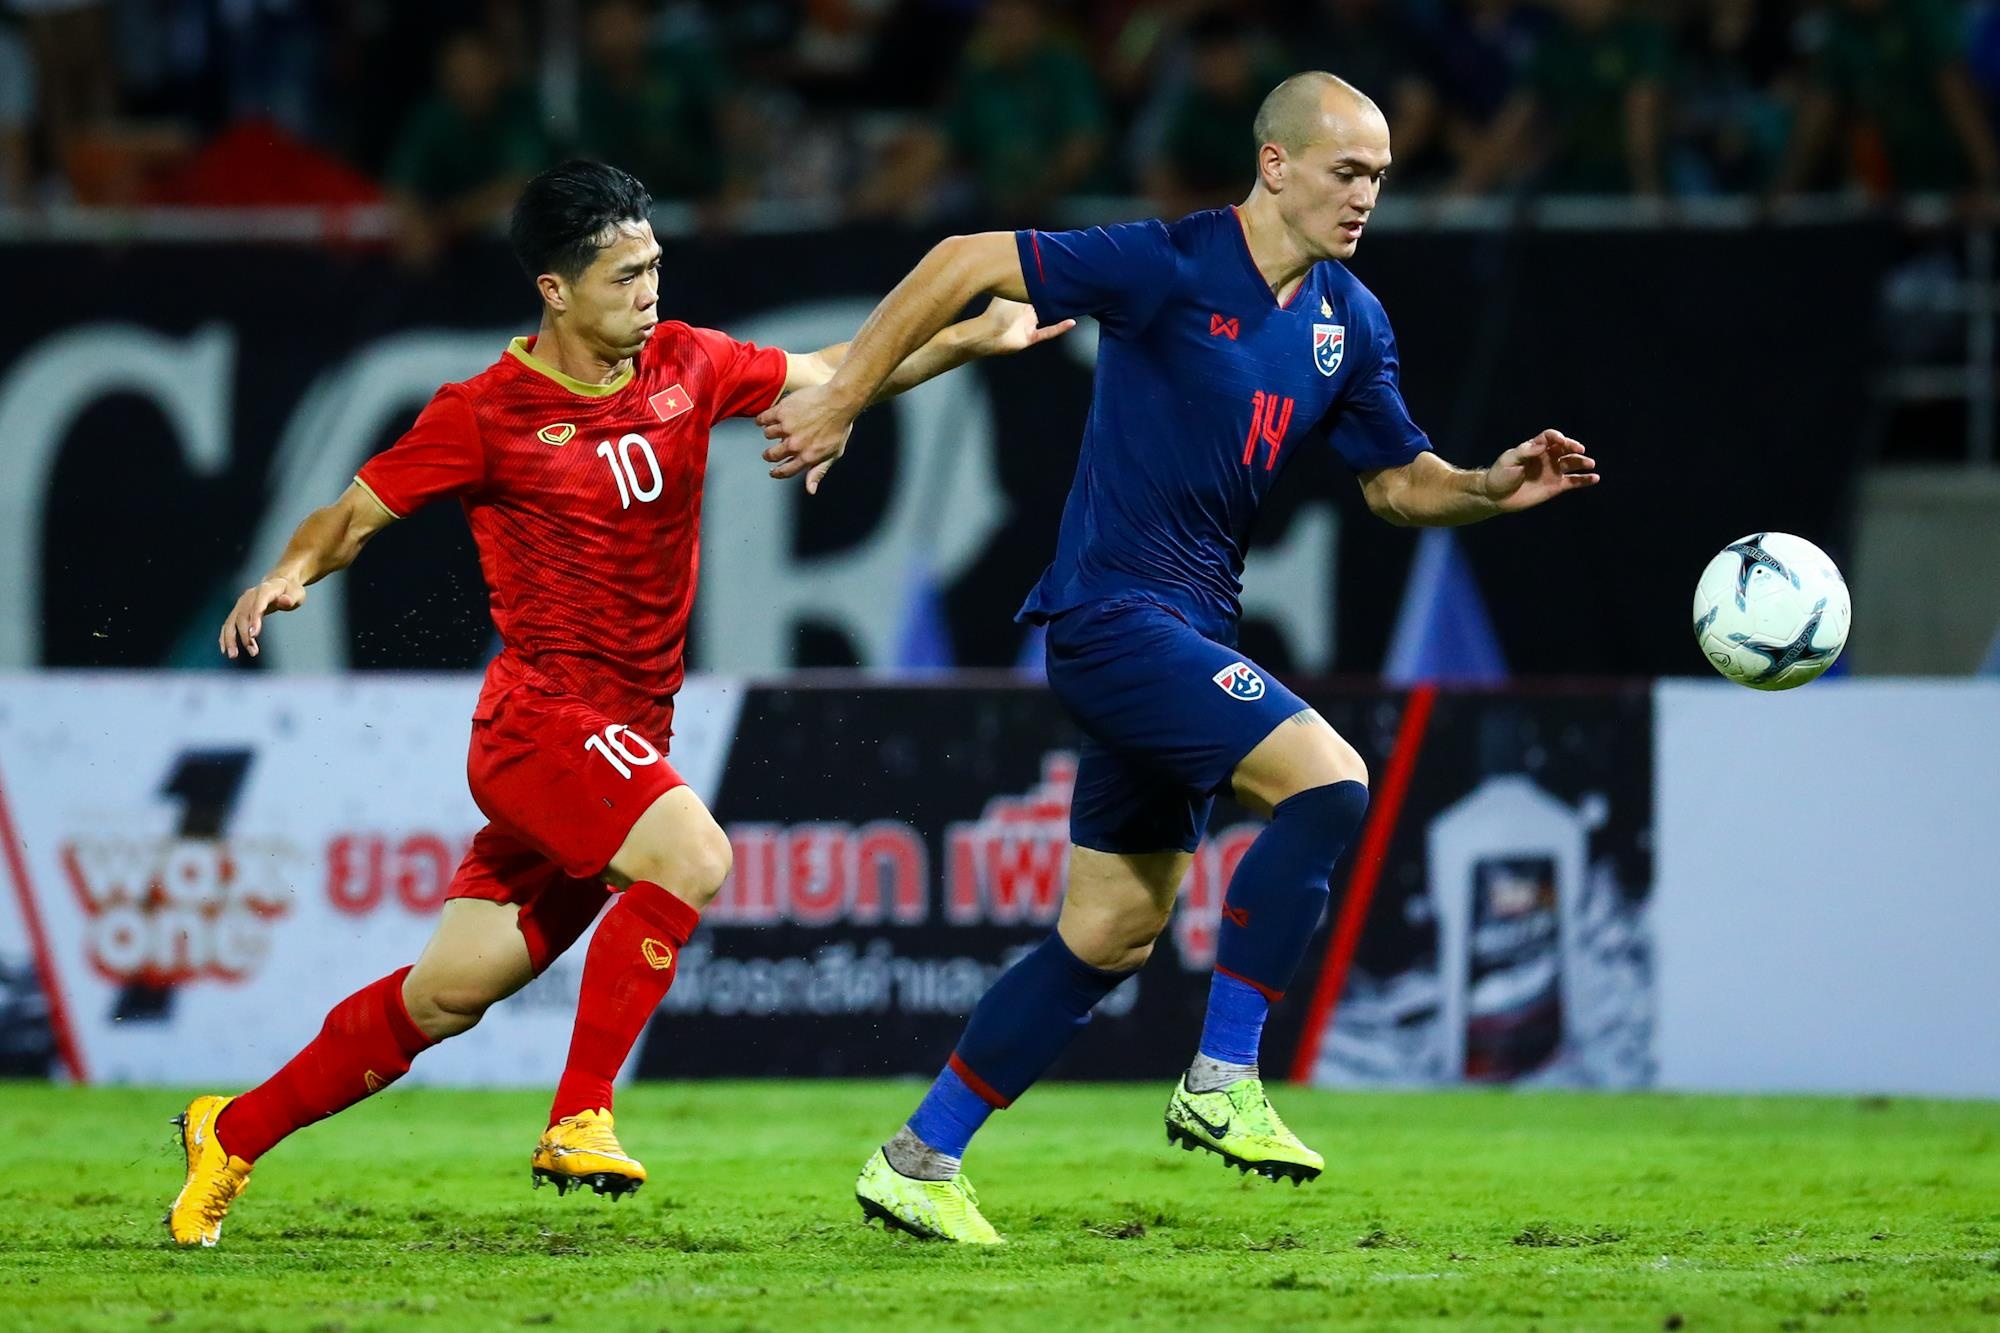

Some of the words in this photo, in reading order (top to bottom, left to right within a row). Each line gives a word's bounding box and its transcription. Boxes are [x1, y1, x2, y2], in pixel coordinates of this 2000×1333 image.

[1242, 390, 1295, 471] 14
[596, 433, 663, 509] 10
[585, 724, 659, 779] 10
